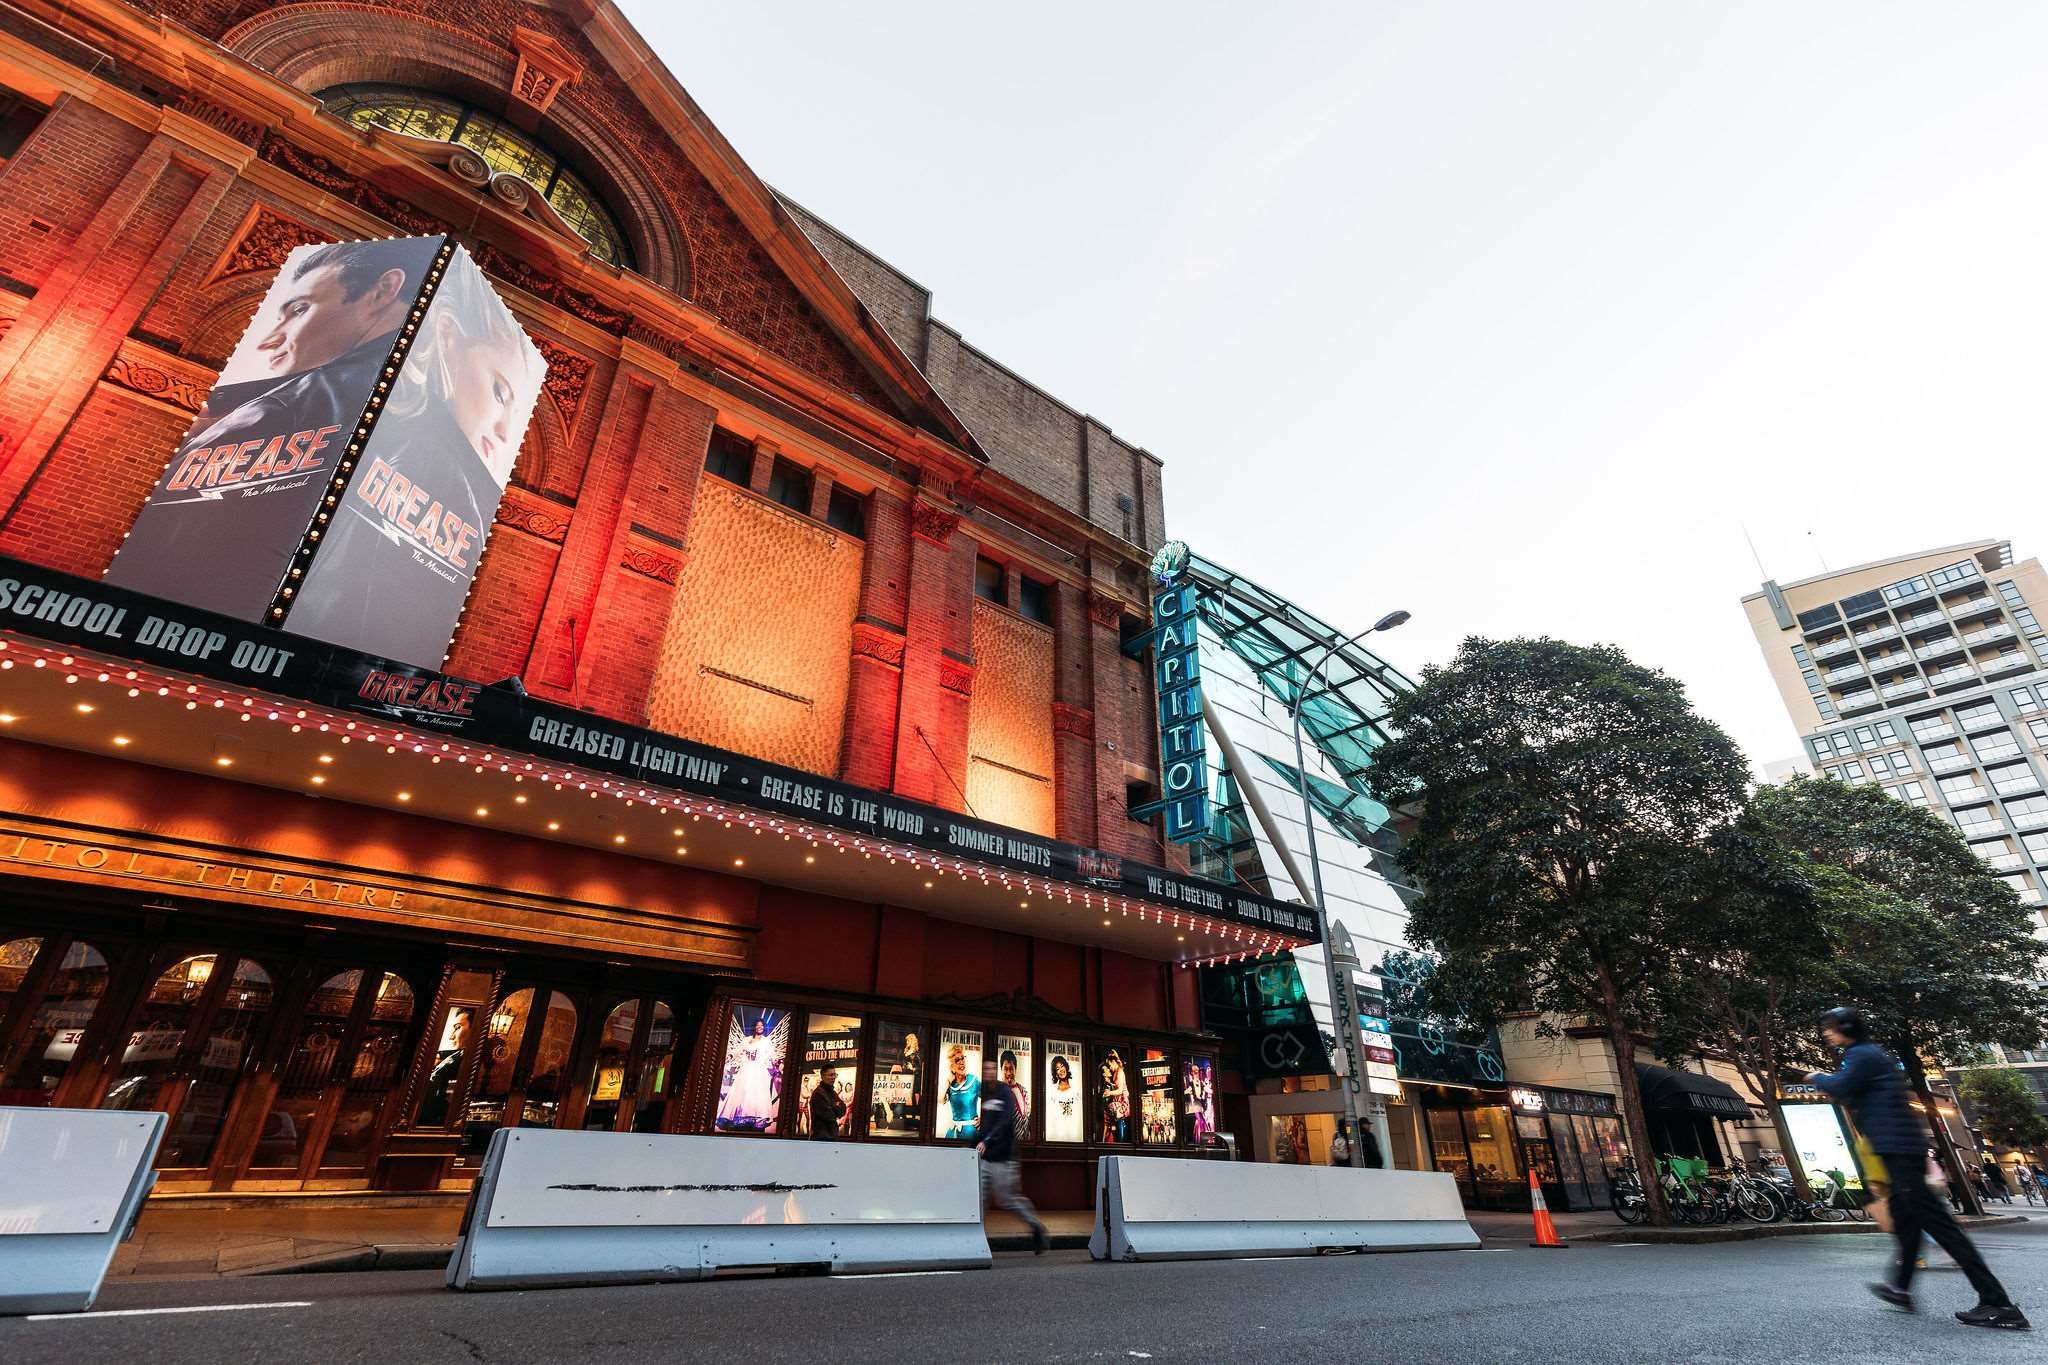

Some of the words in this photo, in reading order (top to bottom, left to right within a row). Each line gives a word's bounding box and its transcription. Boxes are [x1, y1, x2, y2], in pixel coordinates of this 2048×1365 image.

[166, 424, 342, 491] GREASE
[241, 487, 261, 498] The
[263, 476, 308, 496] Musical
[356, 457, 478, 568] GREASE
[411, 549, 426, 567] The
[427, 558, 457, 584] Musical
[0, 578, 127, 638] SCHOOL
[136, 615, 227, 660] DROP
[230, 639, 295, 677] OUT
[358, 671, 482, 716] GREASE
[1159, 592, 1192, 829] CAPITOL
[415, 714, 430, 725] The
[431, 715, 464, 728] Musical
[528, 715, 626, 761] GREASED
[760, 775, 822, 810] GREASE
[827, 792, 844, 815] IS
[851, 798, 877, 824] THE
[883, 807, 923, 835] WORD
[948, 825, 1004, 857] SUMMER
[1007, 840, 1051, 867] NIGHTS
[197, 864, 406, 909] THEATRE
[1077, 853, 1122, 879] GREASE
[1147, 874, 1163, 895] WE
[1165, 879, 1178, 899] GO
[1180, 882, 1223, 910] TOGETHER
[1237, 899, 1260, 919] BORN
[1261, 904, 1272, 921] TO
[1273, 906, 1294, 928] HAND
[1296, 912, 1314, 933] JIVE
[1335, 970, 1351, 1028] SQUARE
[806, 1050, 827, 1061] (STILL)
[828, 1050, 838, 1059] THE
[826, 1040, 846, 1049] GREASE
[847, 1040, 853, 1048] IS
